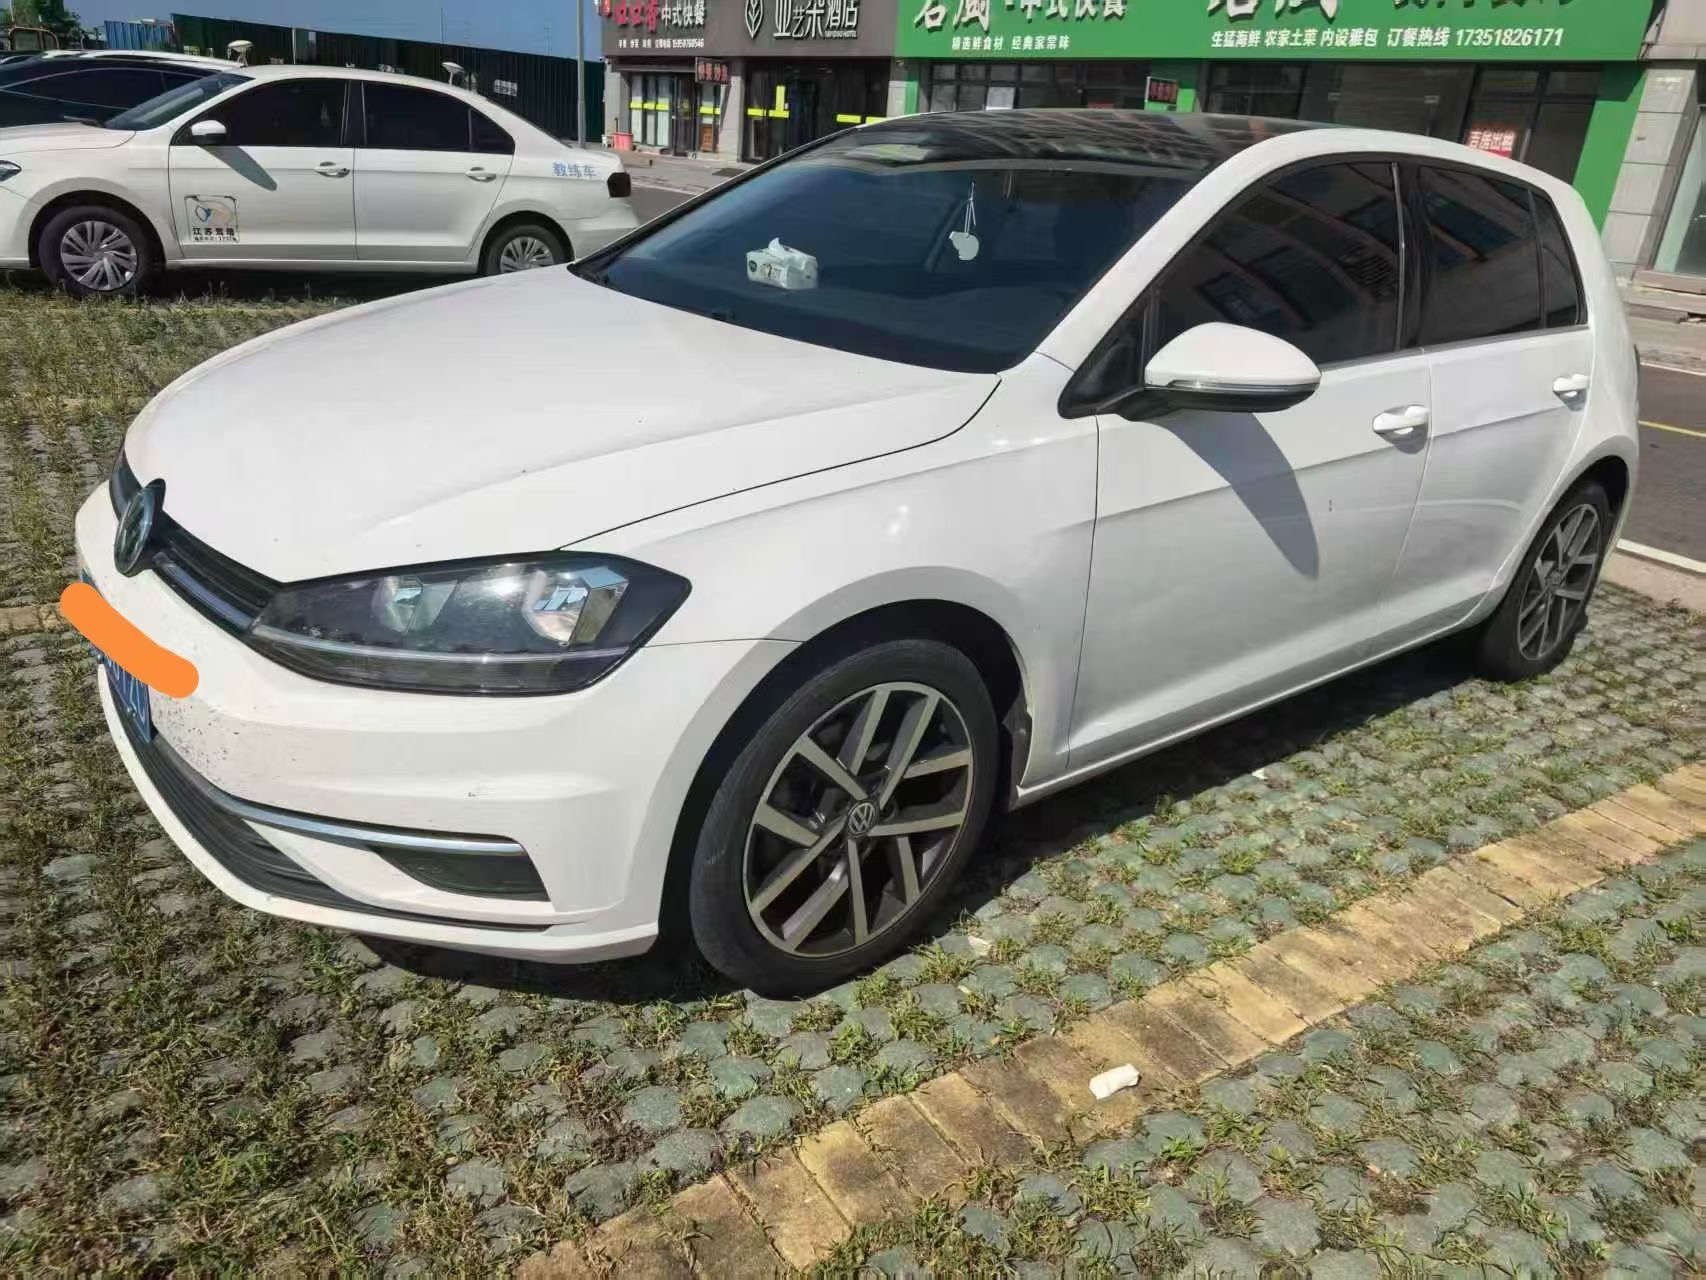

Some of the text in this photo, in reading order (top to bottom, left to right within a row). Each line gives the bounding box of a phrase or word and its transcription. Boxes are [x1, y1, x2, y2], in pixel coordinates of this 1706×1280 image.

[1210, 27, 1565, 48] 生猛海鲜 农家土菜 内设雅包 订餐热线 17351826171
[552, 161, 598, 178] 教练车
